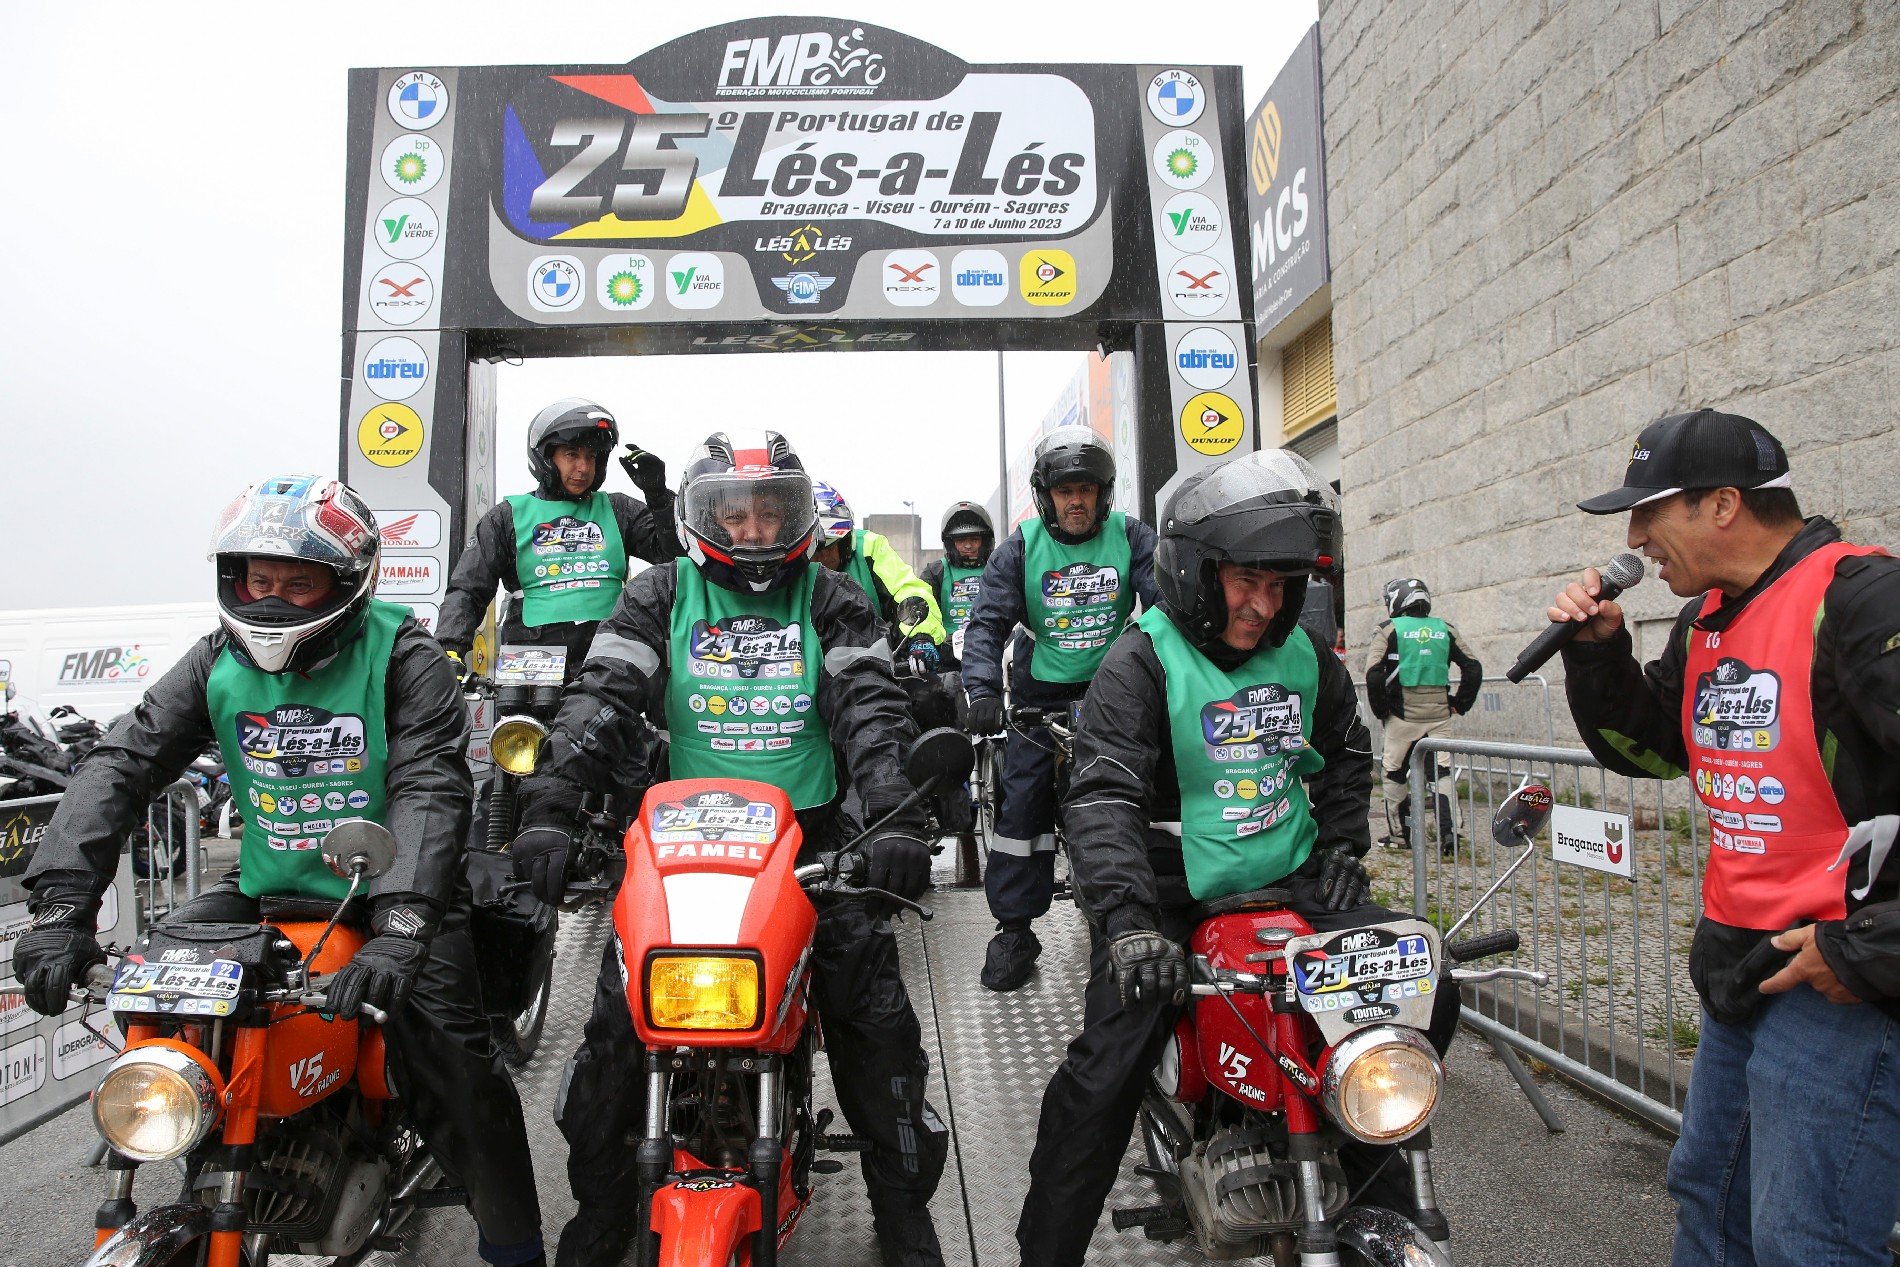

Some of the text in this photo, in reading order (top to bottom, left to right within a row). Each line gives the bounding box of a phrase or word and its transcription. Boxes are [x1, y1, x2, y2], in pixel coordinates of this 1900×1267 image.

[717, 32, 833, 86] FMP
[715, 87, 874, 97] FEDERAÇÃO MOTOCICLISMO PORTUGAL
[774, 111, 965, 133] Portugal de
[414, 140, 430, 152] bp
[1185, 136, 1200, 147] bp
[718, 112, 1085, 198] Lés-a-Lés
[760, 200, 1069, 217] Bragança Viseu Ourém Sagres
[933, 218, 1062, 229] 7 a 10 de Junho 2023
[1189, 224, 1218, 232] VERDE
[1192, 216, 1207, 224] VIA
[1252, 167, 1309, 282] MCS
[404, 229, 433, 238] VERDE
[628, 256, 646, 269] bp
[1273, 239, 1311, 285] CONSTRUÇÃO
[692, 282, 721, 290] VERDE
[792, 282, 815, 294] FIM
[956, 273, 1003, 287] abreu
[1179, 349, 1235, 369] abreu
[367, 359, 424, 379] abreu
[1633, 448, 1650, 461] LÉS
[238, 525, 309, 541] SHARK
[382, 566, 430, 578] YAMAHA
[730, 619, 755, 631] FMP
[59, 648, 122, 681] FMP
[1248, 687, 1269, 703] FMP
[276, 709, 302, 723] FMP
[277, 727, 361, 751] Lés-a-Lés
[697, 809, 772, 827] Lés-a-Lés
[1557, 832, 1604, 853] Bragança
[657, 844, 763, 861] FAMEL
[1341, 932, 1367, 952] FMP
[1357, 950, 1388, 960] Portugal
[1406, 939, 1417, 954] 12
[159, 949, 187, 962] FMP
[219, 964, 235, 977] 22
[1347, 954, 1428, 978] Lés-a-Lés
[153, 966, 238, 991] Lés-a-Lés
[1218, 1041, 1253, 1079] V5
[290, 1050, 325, 1096] V5
[1238, 1082, 1266, 1102] RACING
